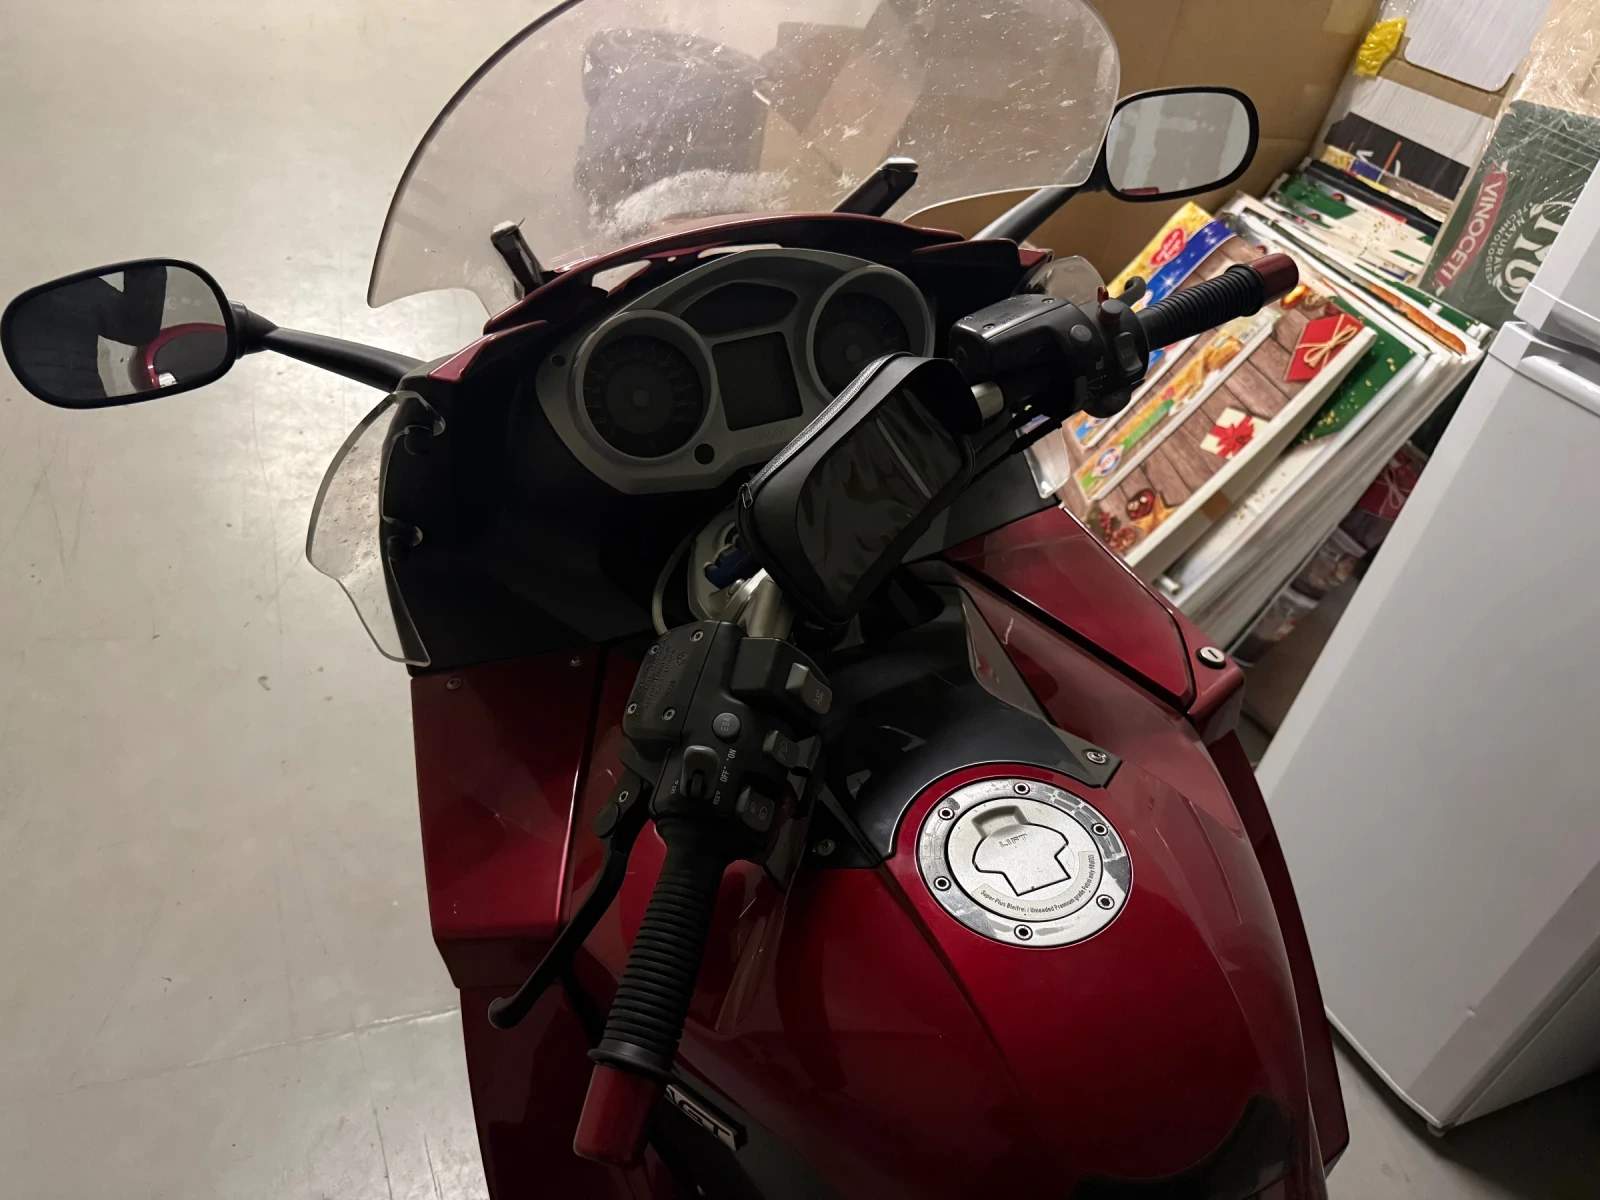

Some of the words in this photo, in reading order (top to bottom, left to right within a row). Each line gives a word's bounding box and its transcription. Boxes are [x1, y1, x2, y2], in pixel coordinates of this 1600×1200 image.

[1440, 181, 1503, 280] VINOCETI
[1485, 205, 1530, 280] TECHNOLOGIES
[1493, 216, 1526, 273] NATURAL
[720, 717, 732, 732] ESA
[727, 748, 737, 759] ON
[719, 769, 730, 783] OFF
[999, 834, 1027, 848] LIFT
[981, 889, 995, 903] Super
[994, 897, 1006, 907] Plus
[1030, 905, 1055, 914] Unleaded
[1054, 898, 1076, 912] Premium
[1073, 889, 1085, 902] grade
[1082, 878, 1093, 893] Petrol
[1088, 869, 1097, 881] only
